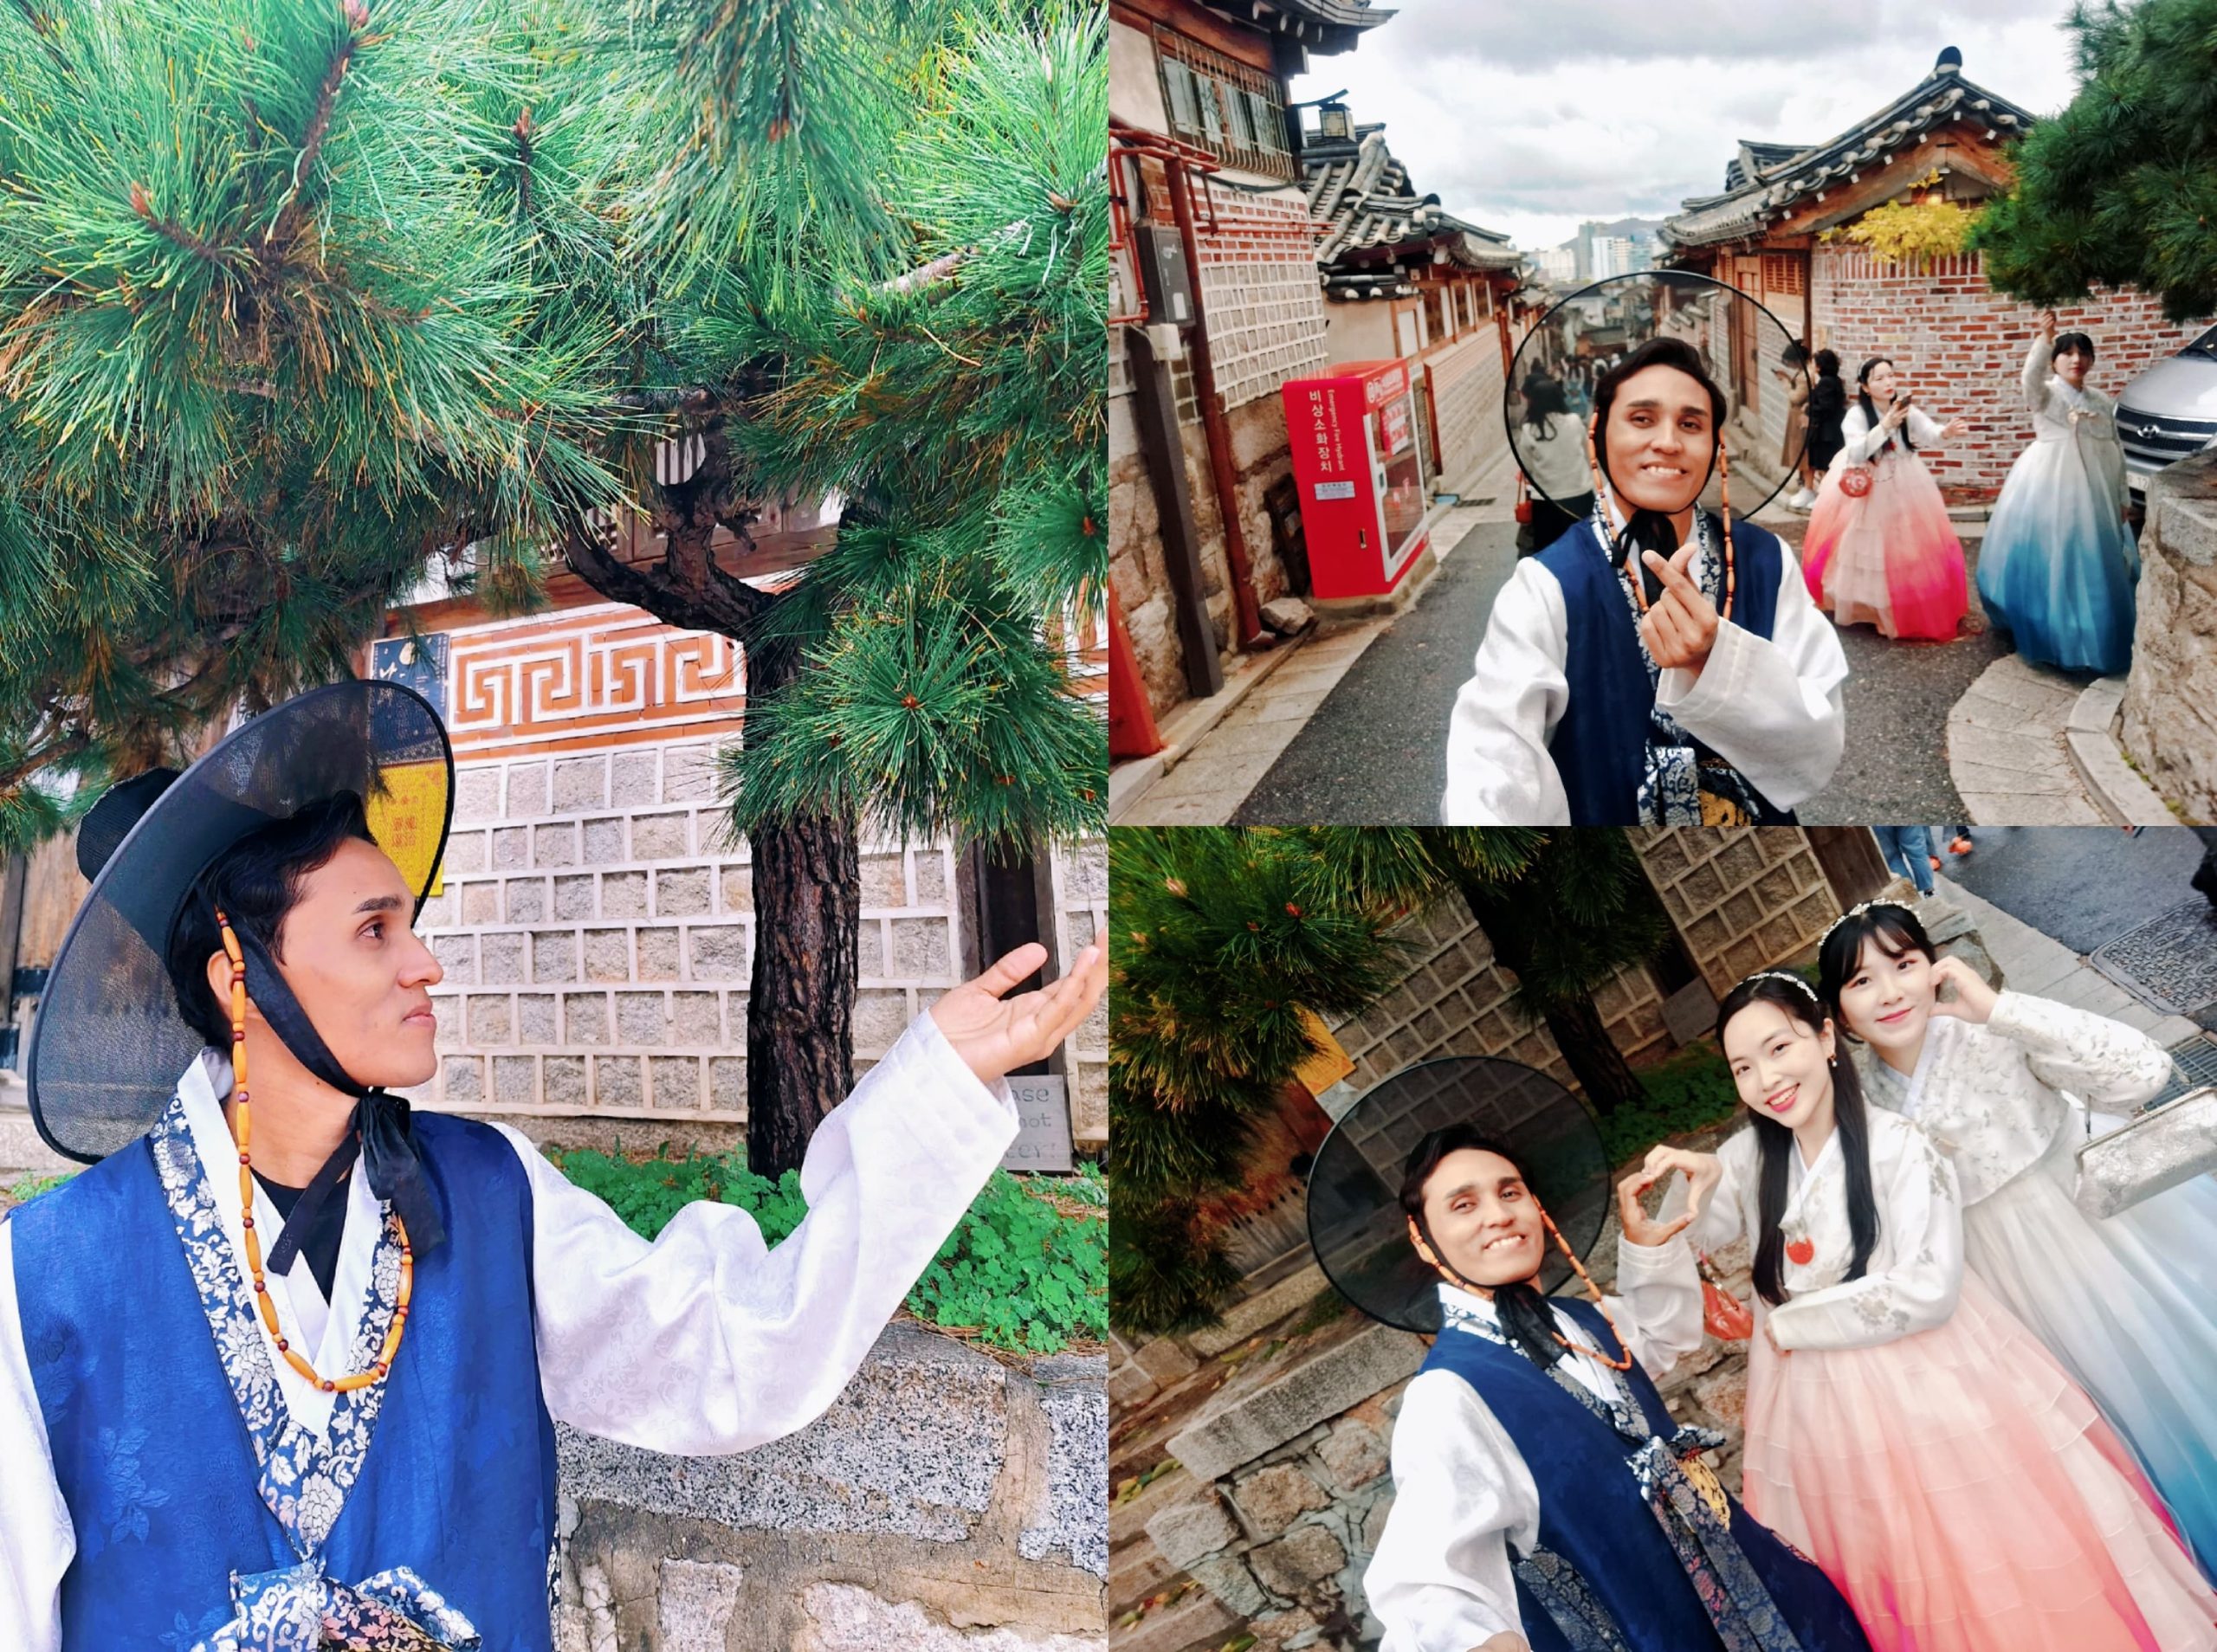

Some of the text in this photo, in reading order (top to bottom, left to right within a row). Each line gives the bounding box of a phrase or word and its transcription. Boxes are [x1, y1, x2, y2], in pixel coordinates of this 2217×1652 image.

[1309, 389, 1332, 473] 비상소화장치
[1327, 389, 1338, 428] Emergency
[1335, 443, 1346, 472] Hydrant
